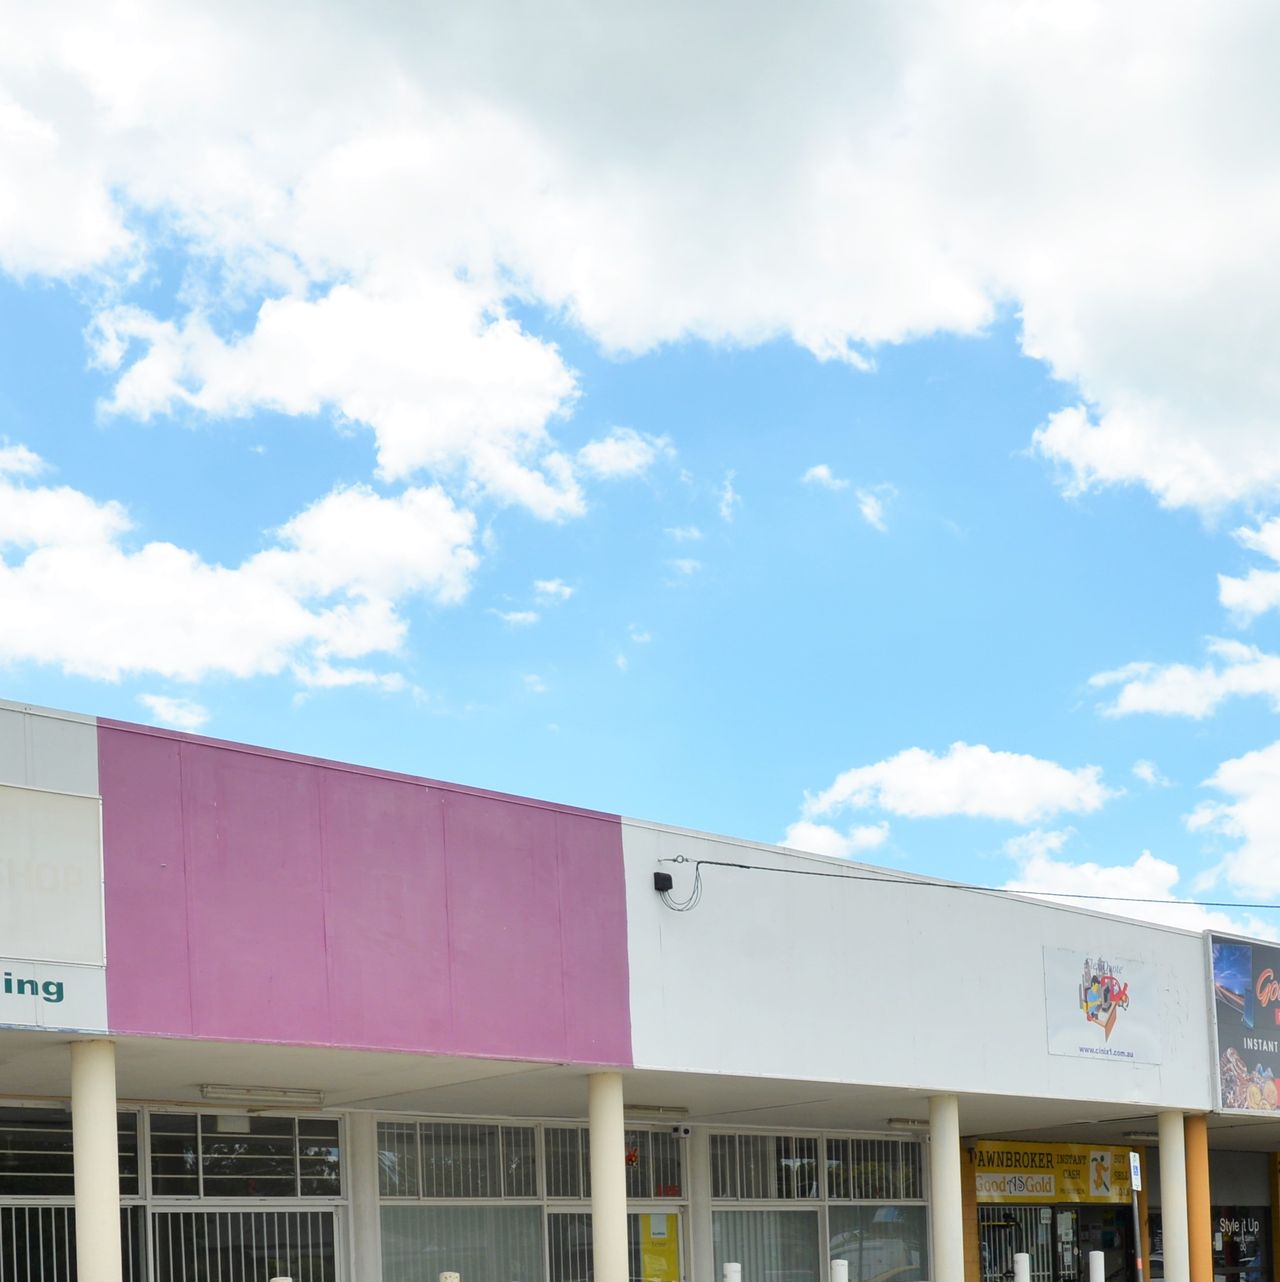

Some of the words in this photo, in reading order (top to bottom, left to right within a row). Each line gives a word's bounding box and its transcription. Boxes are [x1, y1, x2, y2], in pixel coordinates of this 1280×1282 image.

[1243, 1037, 1278, 1053] INSTANT
[1056, 1154, 1087, 1165] INSTANT
[1220, 1218, 1240, 1235] Style
[1248, 1218, 1260, 1234] Up
